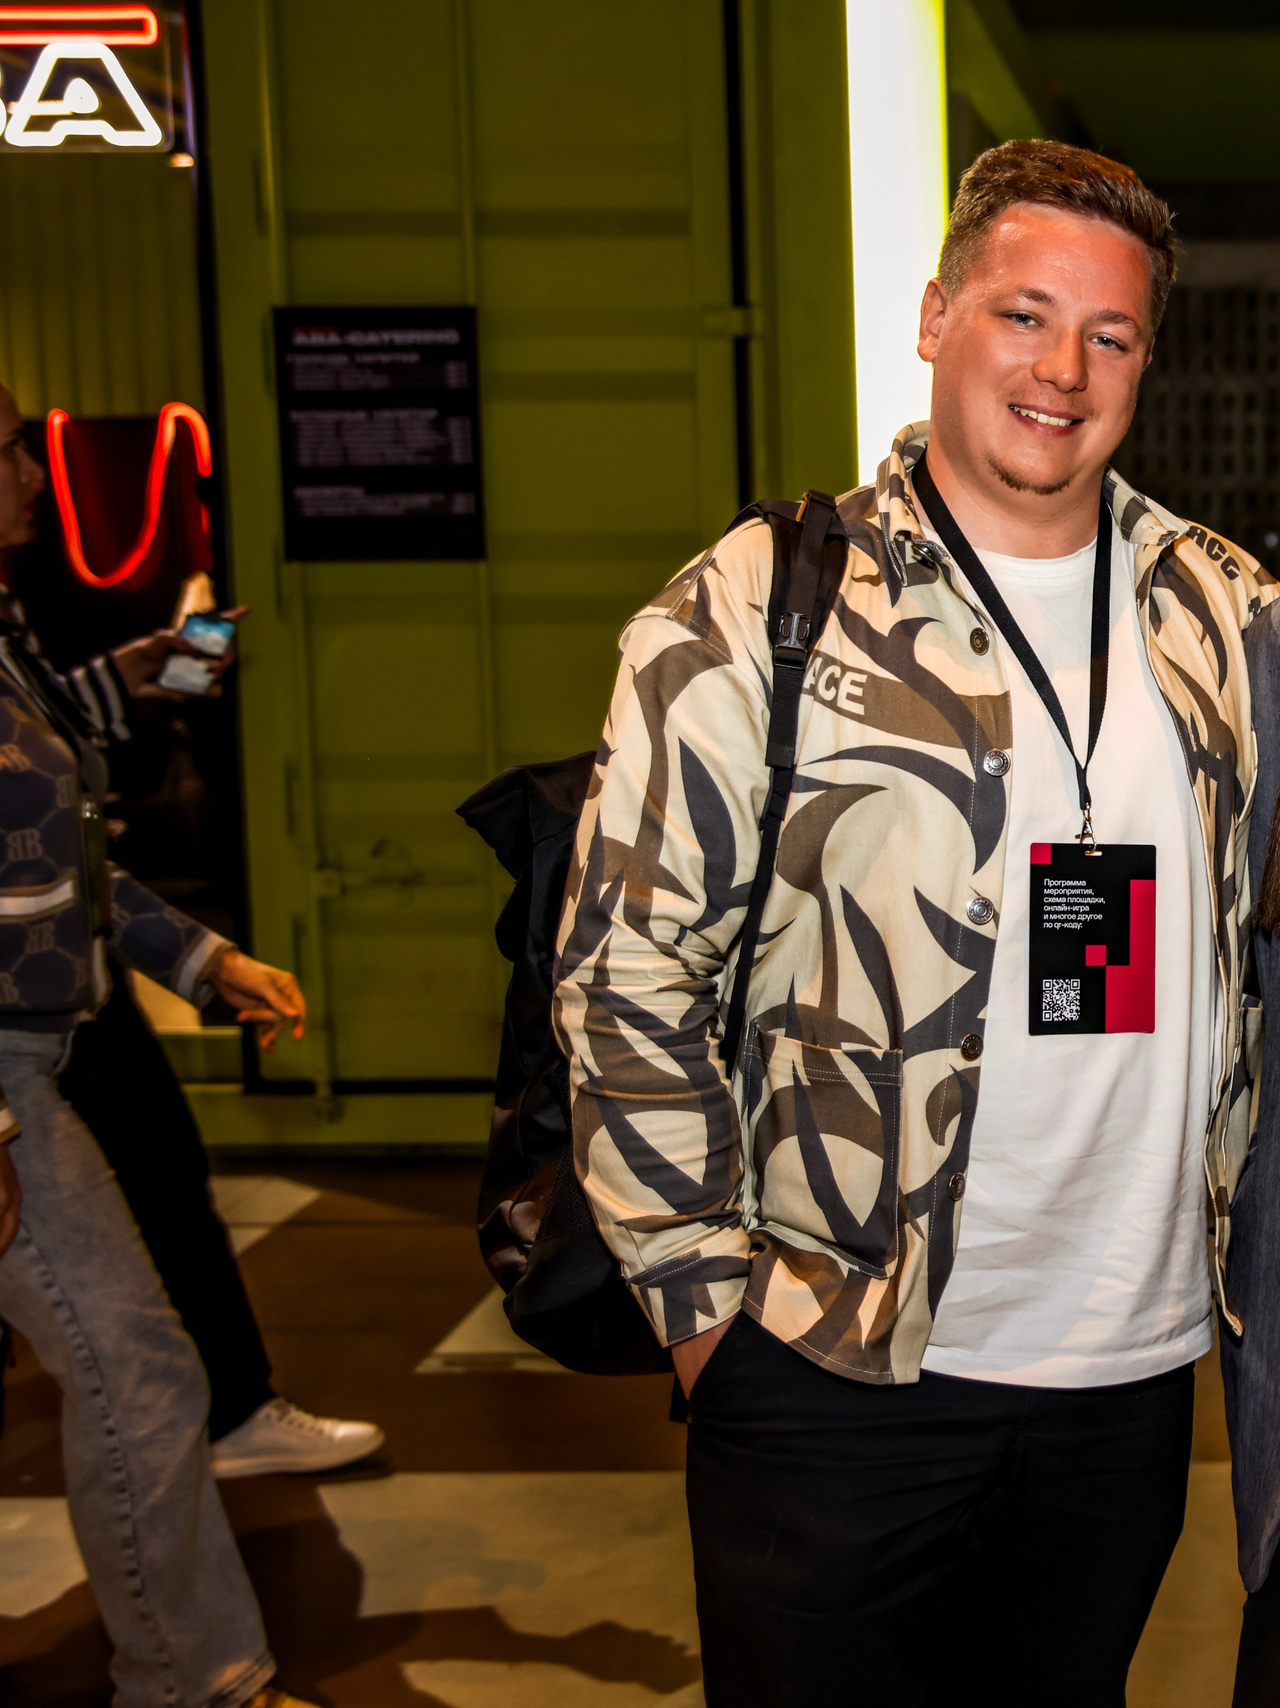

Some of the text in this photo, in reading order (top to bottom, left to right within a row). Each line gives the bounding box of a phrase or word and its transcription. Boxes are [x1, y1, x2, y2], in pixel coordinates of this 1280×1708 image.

[1044, 878, 1086, 887] Программа
[1044, 888, 1094, 896] мероприятия,
[1044, 904, 1089, 912] онлайн-игра
[1054, 922, 1083, 930] qr-коду:
